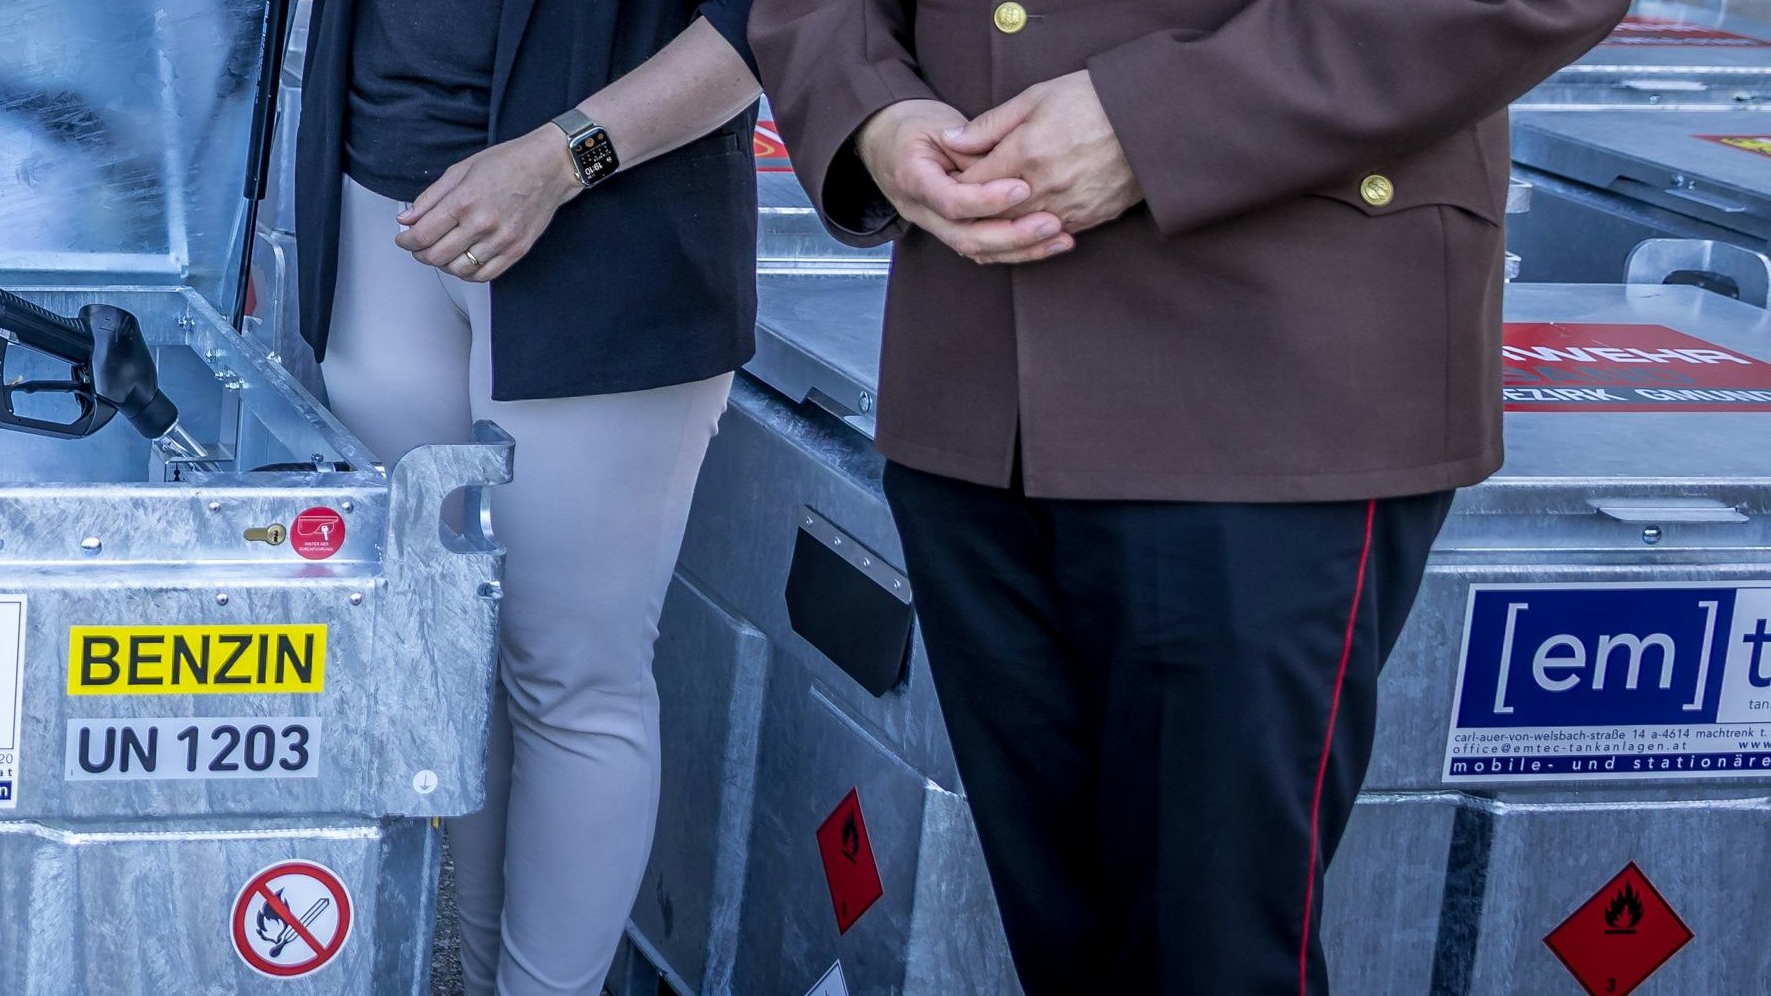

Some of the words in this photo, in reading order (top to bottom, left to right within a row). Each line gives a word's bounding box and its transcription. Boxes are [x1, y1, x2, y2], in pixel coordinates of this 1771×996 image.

[584, 162, 603, 175] 19:10
[1502, 345, 1753, 364] WEHR
[1503, 388, 1629, 401] EZIRK
[81, 633, 315, 686] BENZIN
[1454, 729, 1627, 742] carl-auer-von-welsbach-straße
[1633, 729, 1646, 740] 14
[1651, 728, 1690, 740] a-4614
[1695, 727, 1755, 739] machtrenk
[79, 725, 159, 773] UN
[177, 724, 309, 772] 1203
[1453, 740, 1688, 755] office@emtec-tankanlagen.at
[1453, 758, 1554, 773] mobile-
[1572, 756, 1617, 771] und
[1633, 753, 1771, 770] stationäre
[1604, 977, 1617, 993] 3
